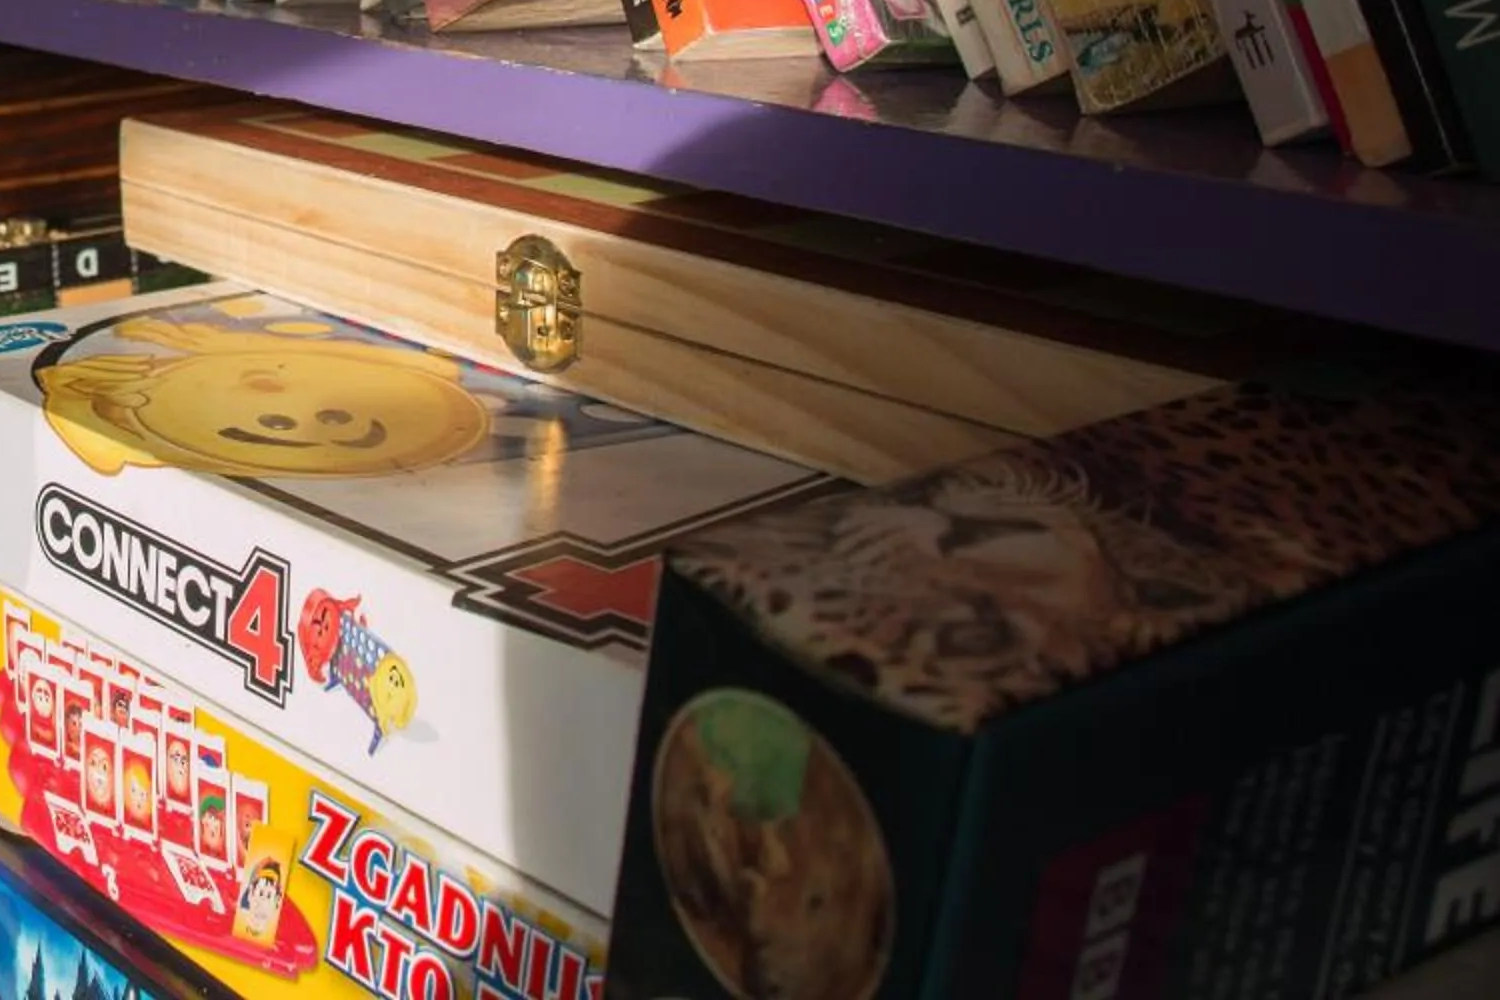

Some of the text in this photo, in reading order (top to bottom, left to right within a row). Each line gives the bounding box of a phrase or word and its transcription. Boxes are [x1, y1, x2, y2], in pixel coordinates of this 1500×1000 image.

[76, 248, 99, 278] D
[43, 497, 286, 686] CONNECT 4
